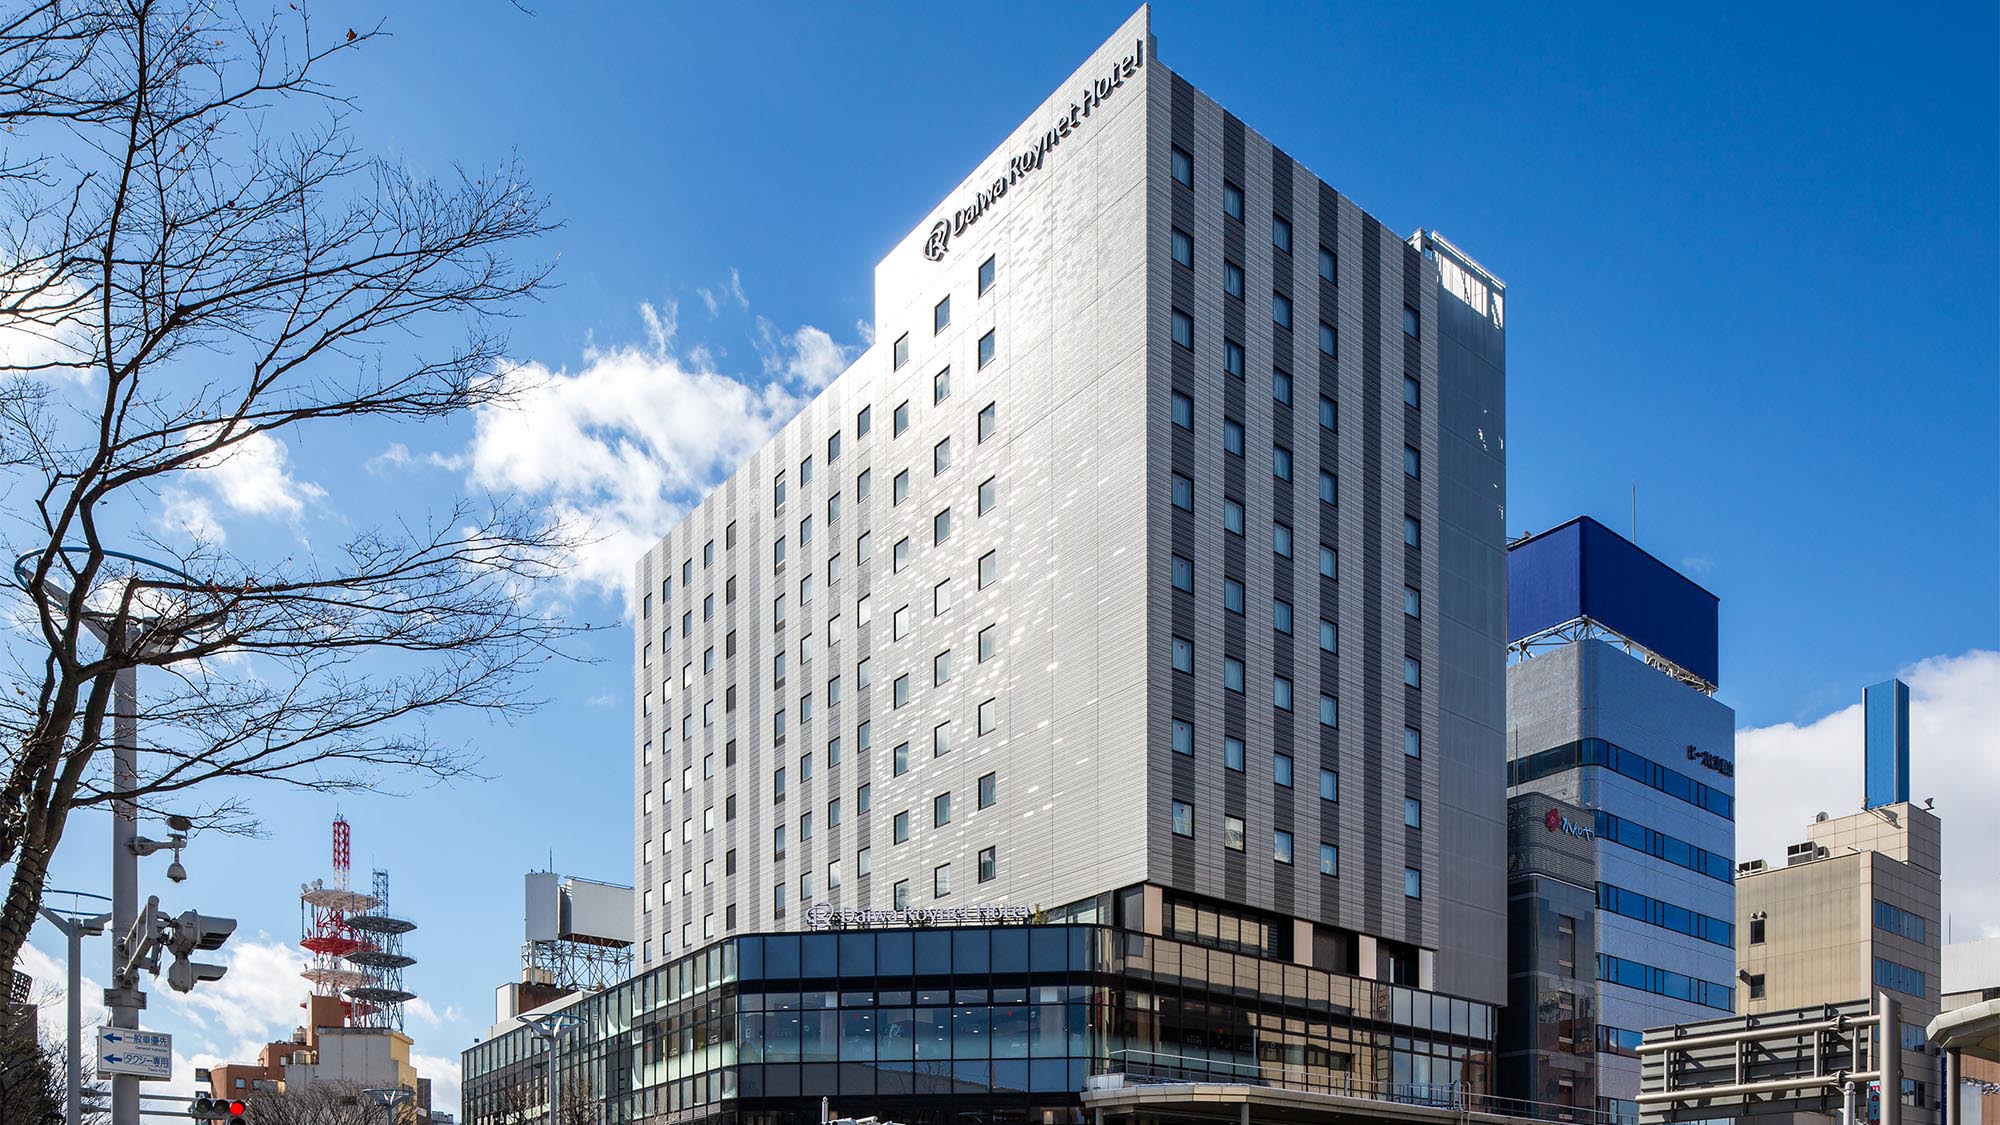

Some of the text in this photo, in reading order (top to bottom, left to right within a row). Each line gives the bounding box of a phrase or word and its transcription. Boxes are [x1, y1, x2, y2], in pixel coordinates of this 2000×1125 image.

[953, 174, 1008, 237] Daiwa
[1009, 103, 1081, 186] Roynet
[1082, 38, 1143, 118] Hotel
[841, 907, 897, 923] Daiwa
[903, 904, 968, 925] Roynet
[976, 901, 1029, 919] Hotel
[125, 1033, 168, 1047] 一般車優先
[124, 1054, 168, 1068] タクシー専用
